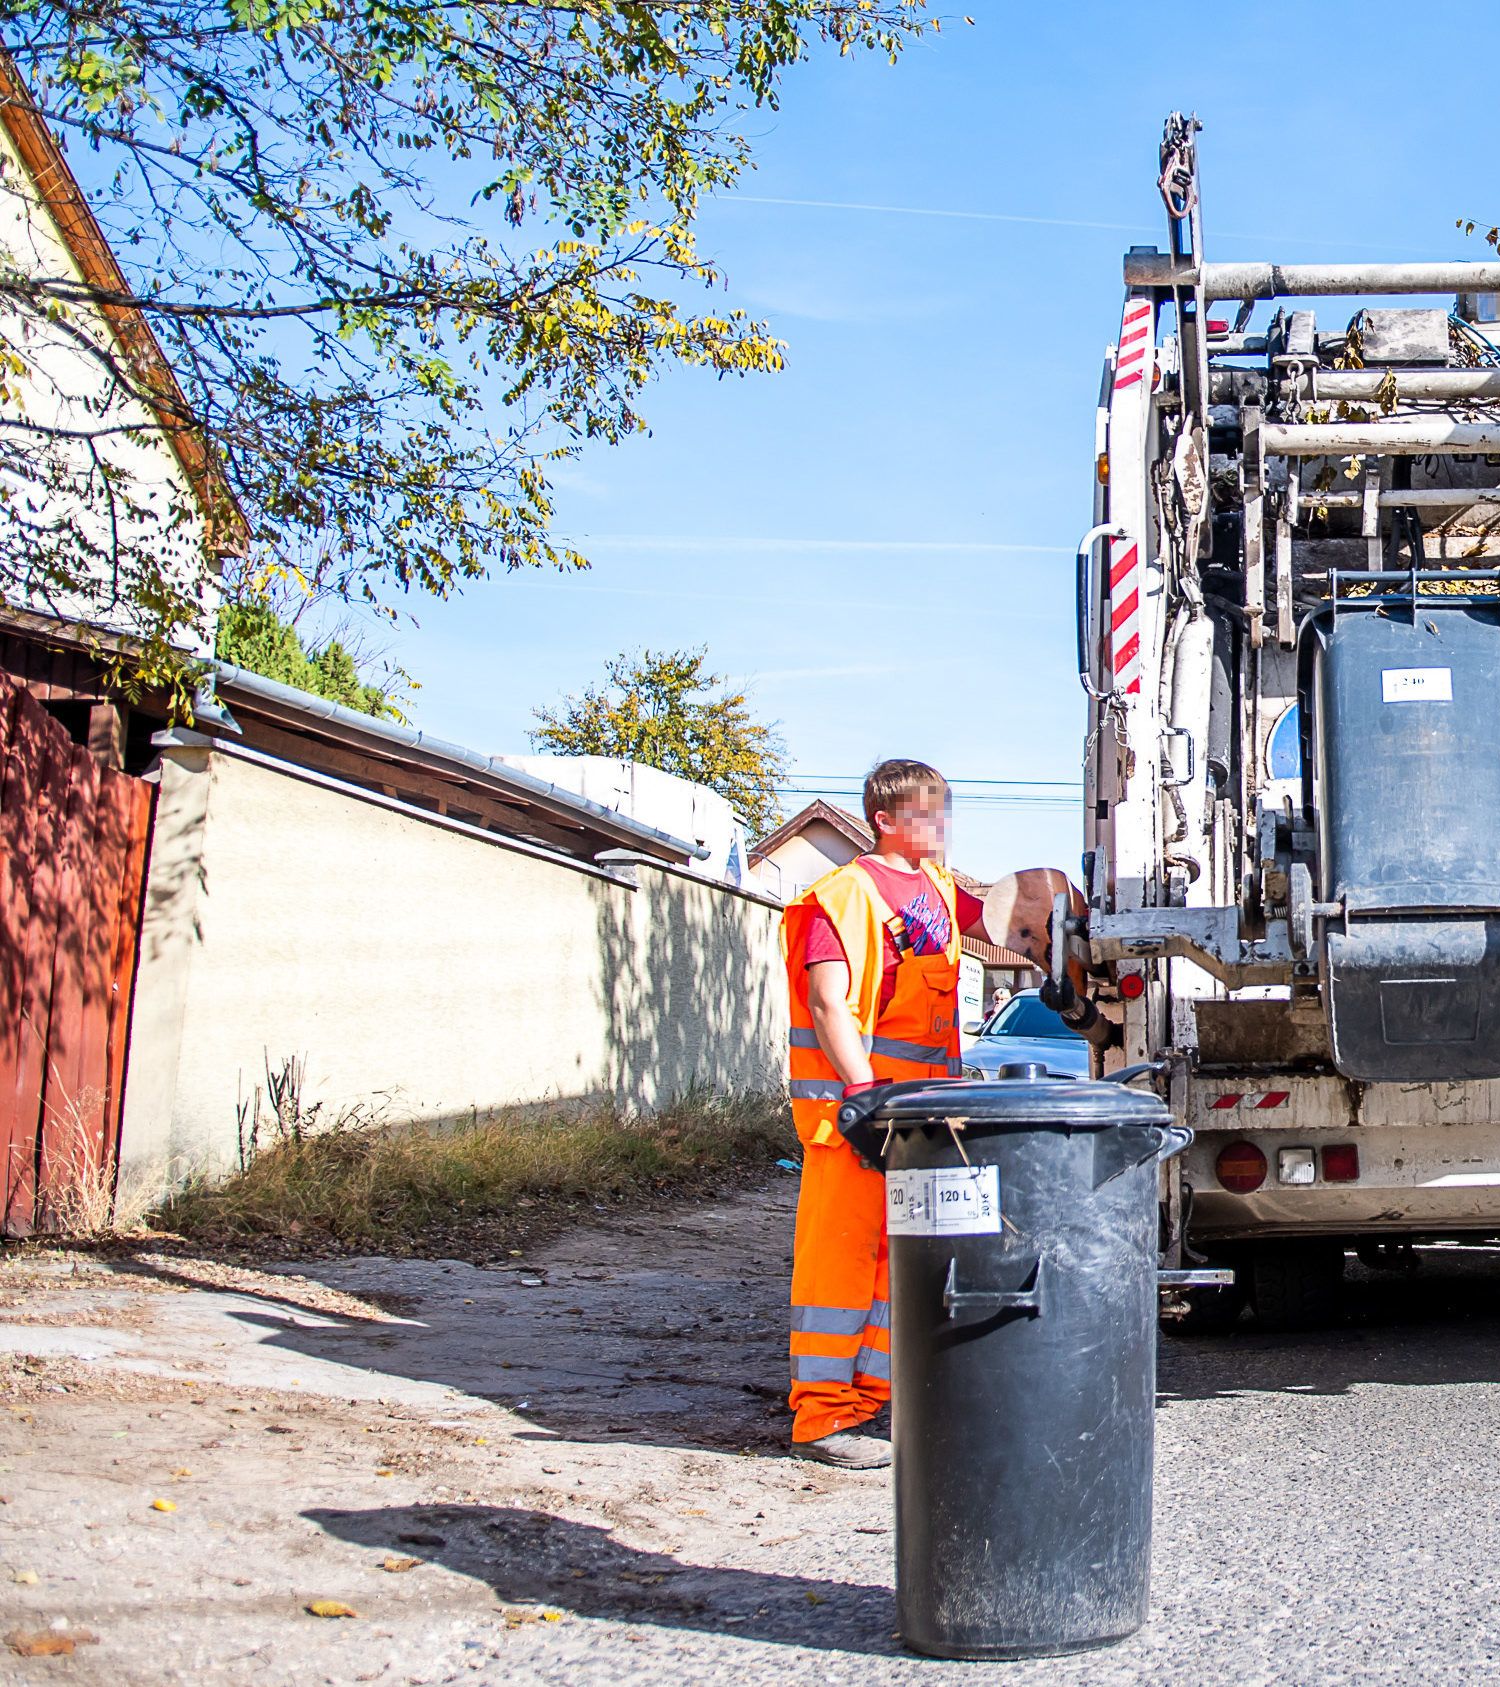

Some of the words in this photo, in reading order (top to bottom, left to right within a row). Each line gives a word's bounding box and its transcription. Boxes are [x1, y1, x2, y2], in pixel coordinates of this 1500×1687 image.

[890, 1188, 904, 1205] 120
[939, 1190, 959, 1203] 120
[963, 1190, 971, 1201] L
[981, 1193, 990, 1217] 2016
